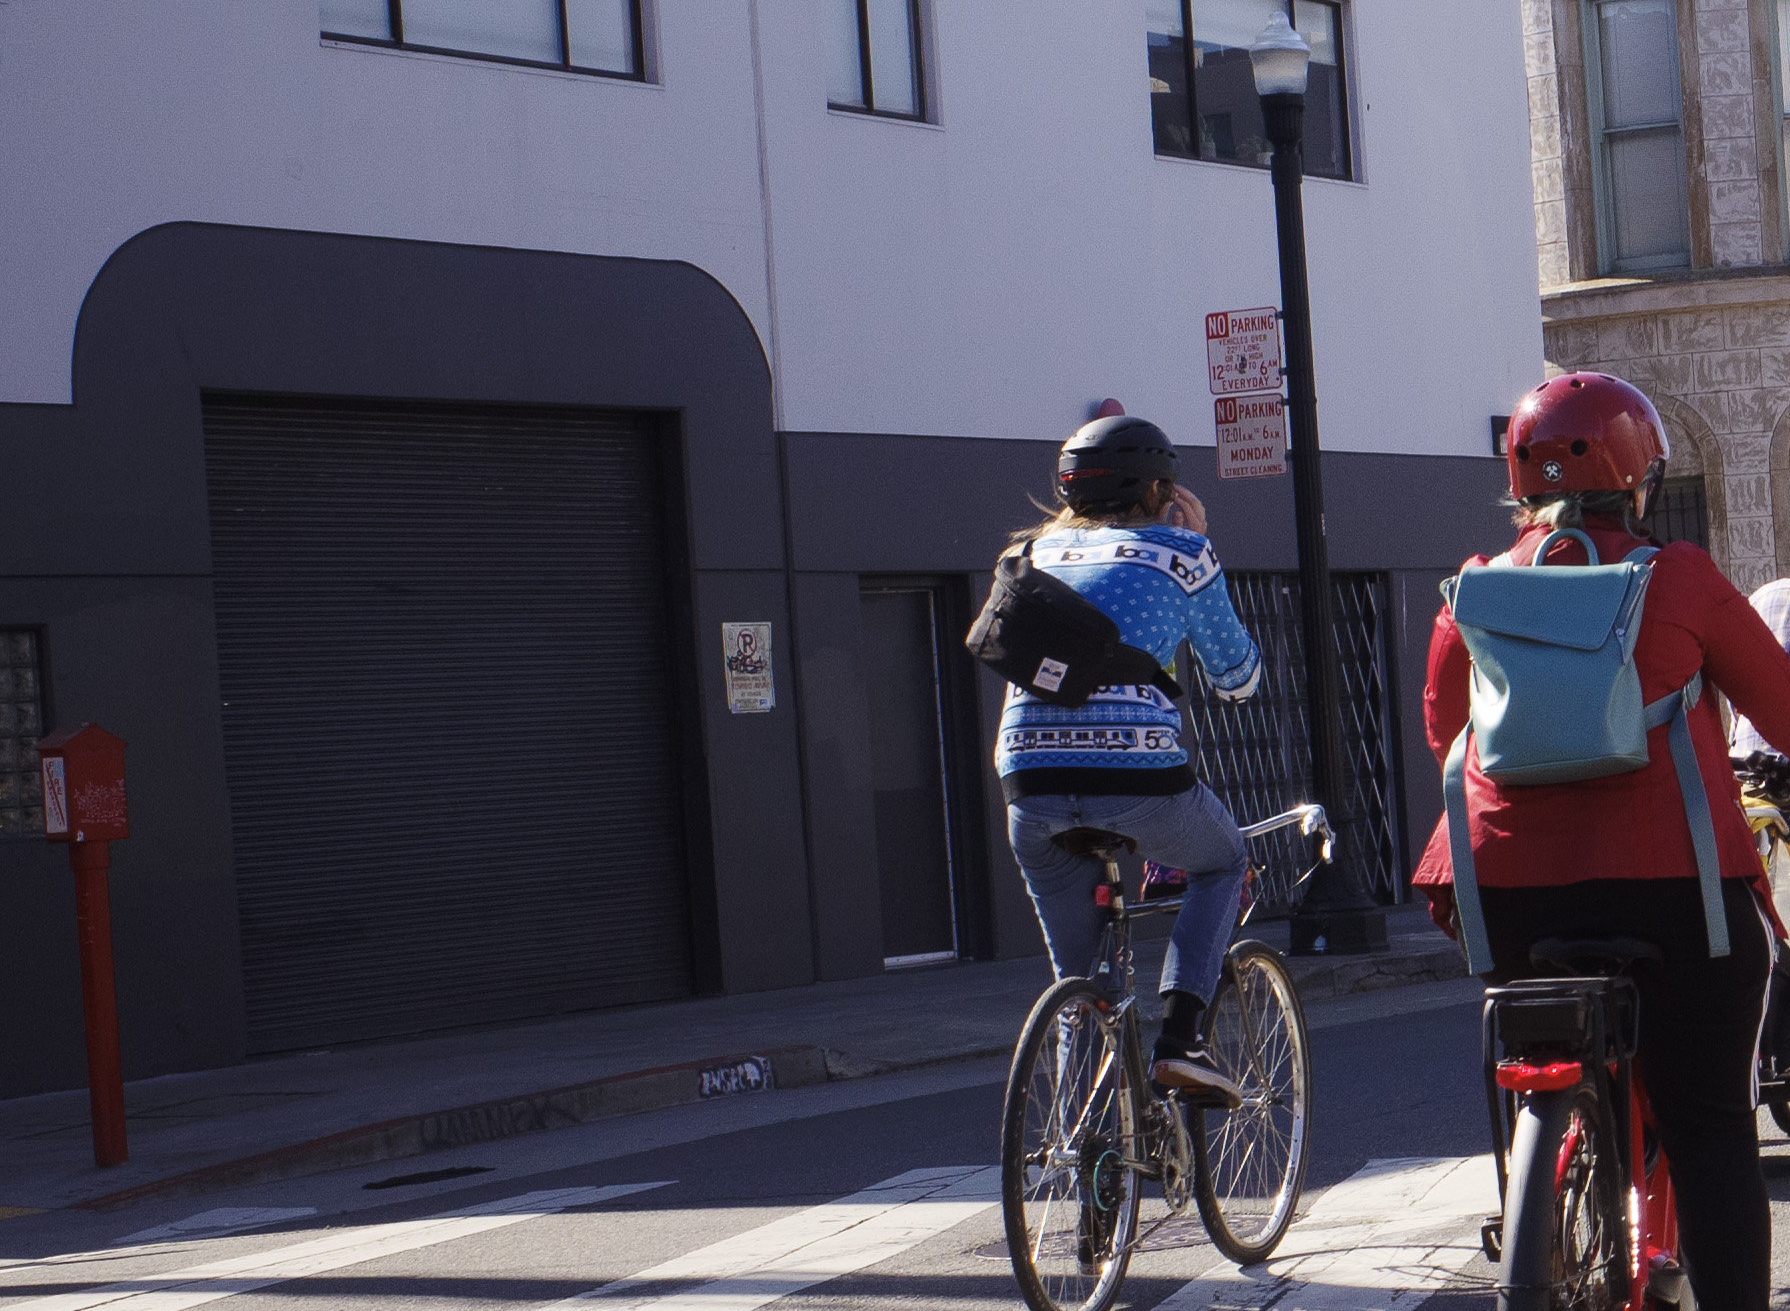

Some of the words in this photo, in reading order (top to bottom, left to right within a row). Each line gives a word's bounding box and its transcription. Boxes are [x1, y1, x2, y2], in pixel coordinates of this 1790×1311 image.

[1208, 315, 1226, 337] NO
[1231, 314, 1274, 334] PARKING
[1260, 361, 1268, 375] 6
[1222, 375, 1270, 391] EVERYDAY
[1216, 400, 1234, 421] NO
[1238, 401, 1281, 419] PARKING
[1221, 427, 1242, 443] 12:01
[1262, 424, 1269, 439] 6
[1230, 446, 1274, 462] MONDAY
[1144, 730, 1174, 750] 50
